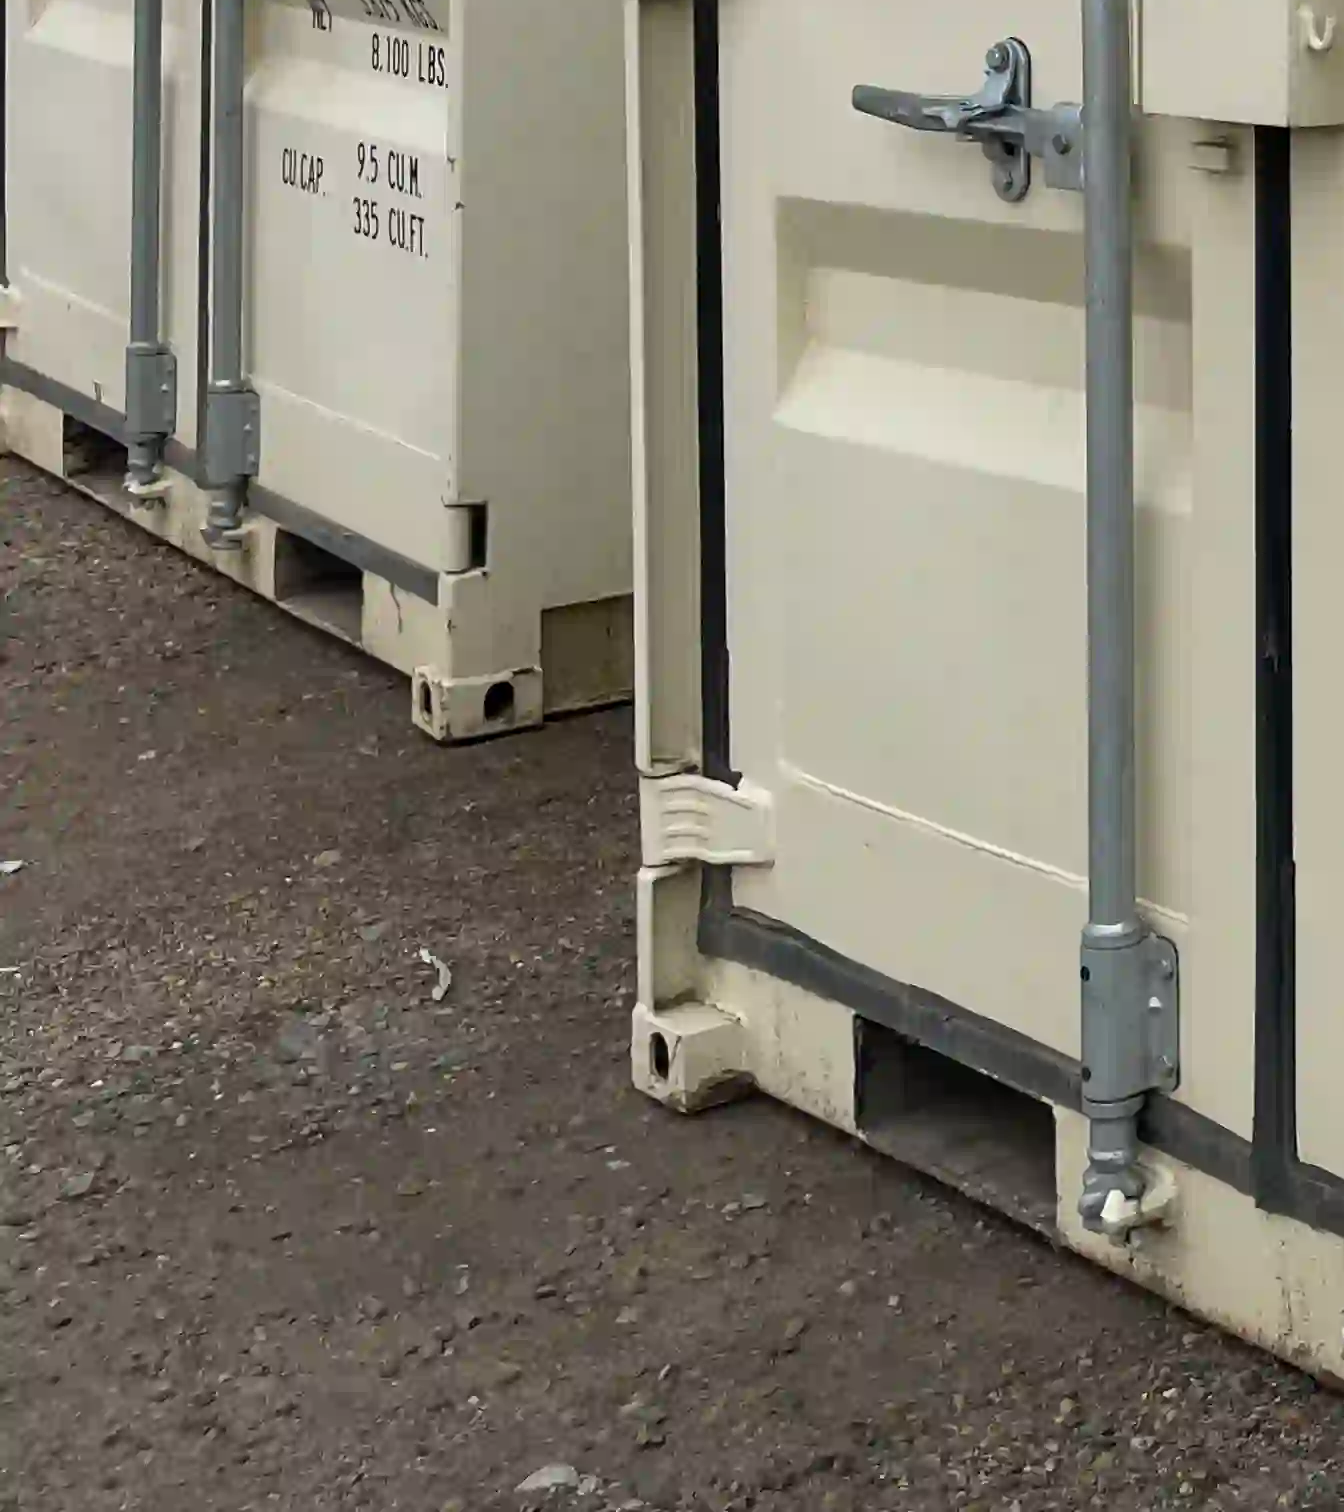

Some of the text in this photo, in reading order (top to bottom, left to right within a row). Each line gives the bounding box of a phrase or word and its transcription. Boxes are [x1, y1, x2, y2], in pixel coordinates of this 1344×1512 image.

[418, 43, 449, 89] LBS.
[357, 142, 379, 183] 9.5
[353, 196, 379, 240] 335
